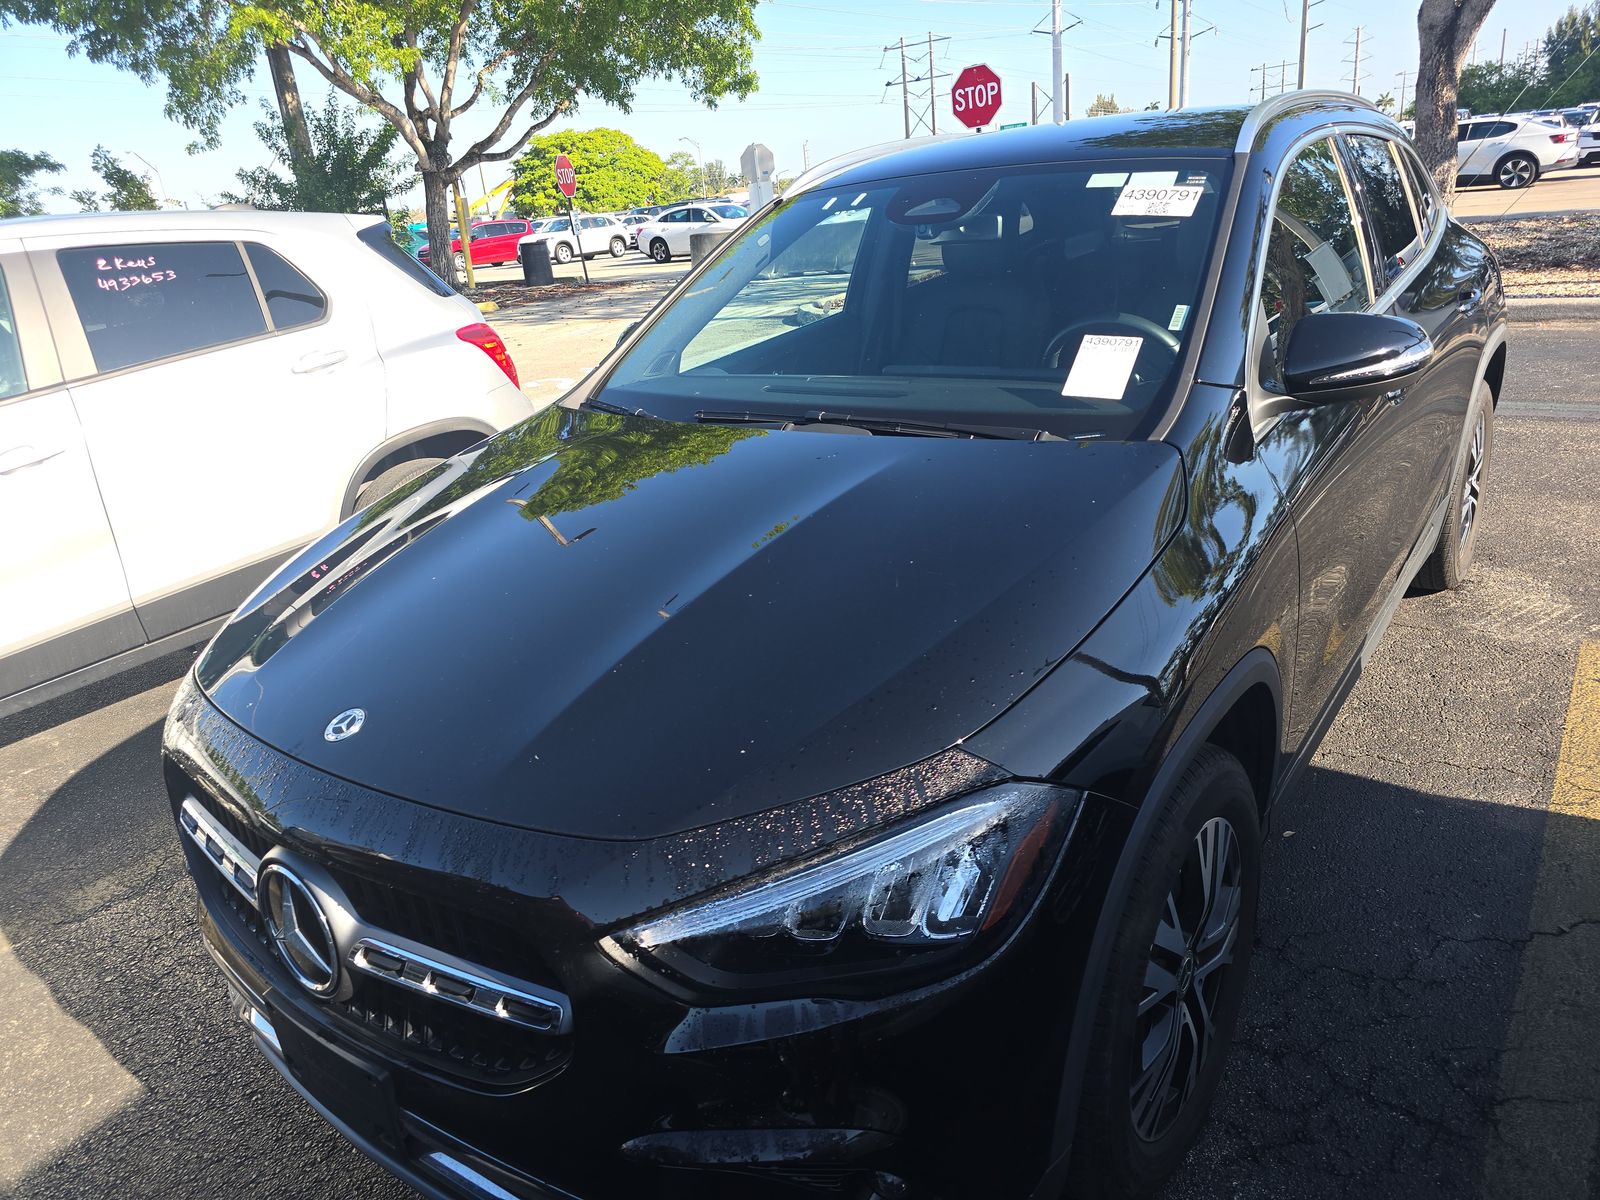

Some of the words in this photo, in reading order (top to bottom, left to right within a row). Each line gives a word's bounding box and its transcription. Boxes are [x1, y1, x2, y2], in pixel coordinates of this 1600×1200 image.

[955, 81, 999, 112] STOP
[557, 168, 574, 185] STOP
[1124, 189, 1199, 201] 4390791
[97, 270, 177, 291] 4933653
[1085, 337, 1140, 347] 4390791
